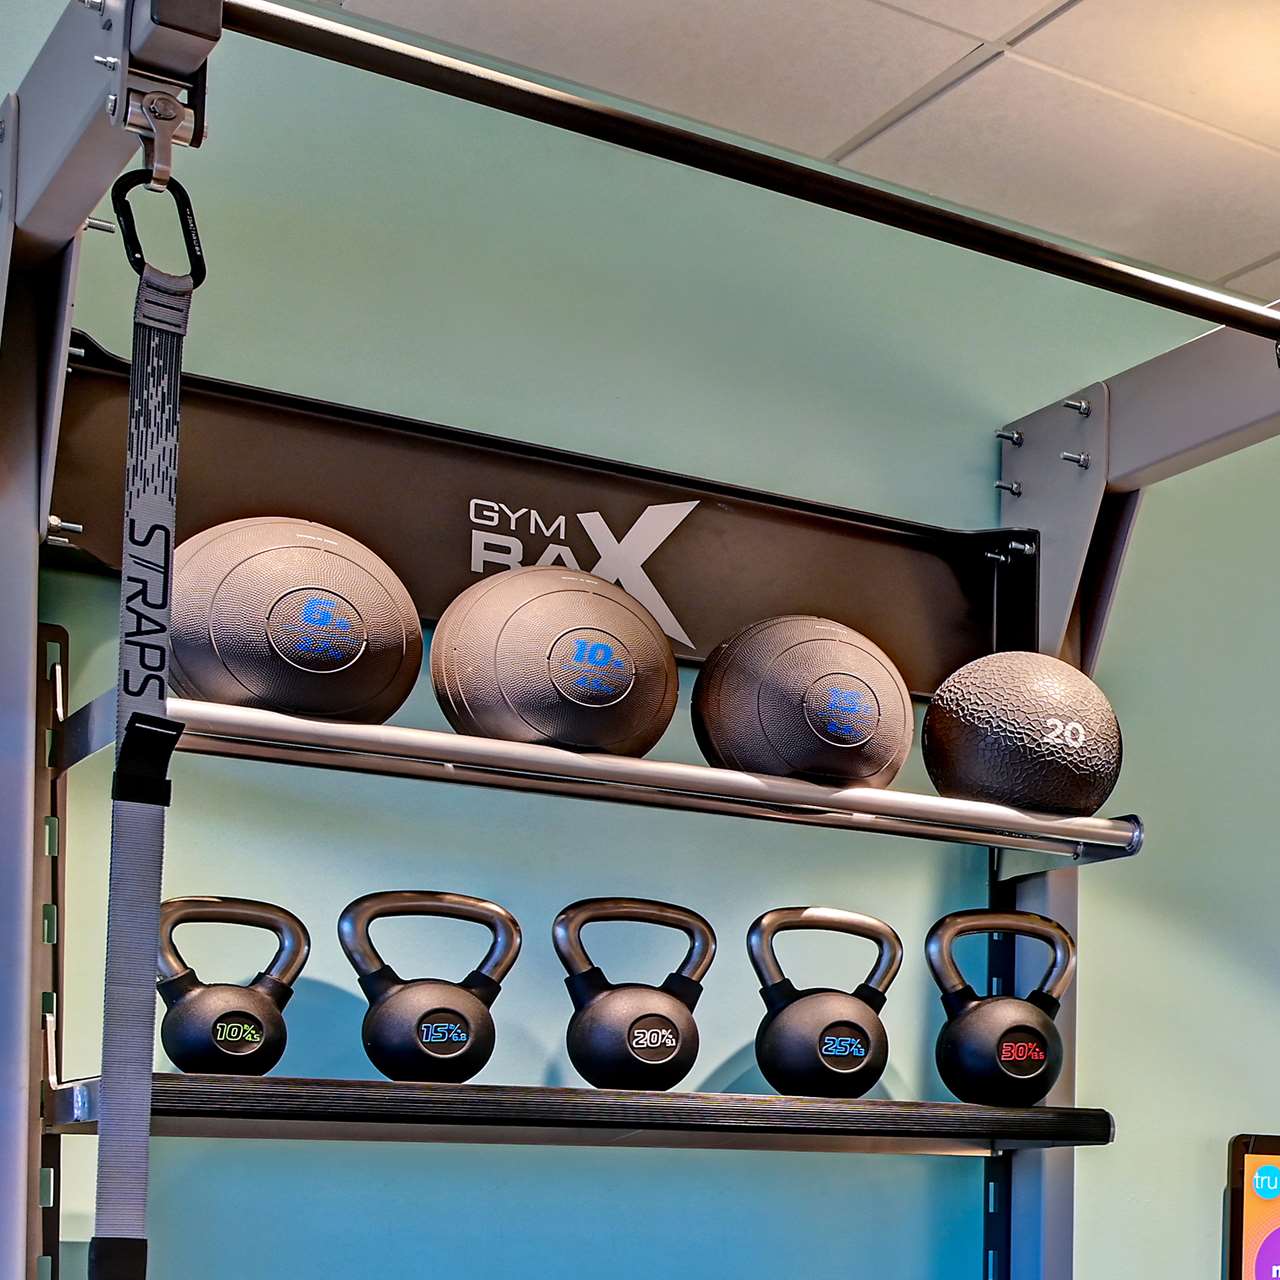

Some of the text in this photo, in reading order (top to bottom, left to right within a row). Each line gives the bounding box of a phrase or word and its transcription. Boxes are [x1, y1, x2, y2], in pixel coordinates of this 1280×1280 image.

[469, 498, 566, 540] GYM
[123, 518, 171, 701] STRAPS
[572, 638, 614, 667] 10
[1041, 719, 1086, 748] 20
[1253, 1171, 1279, 1190] tru
